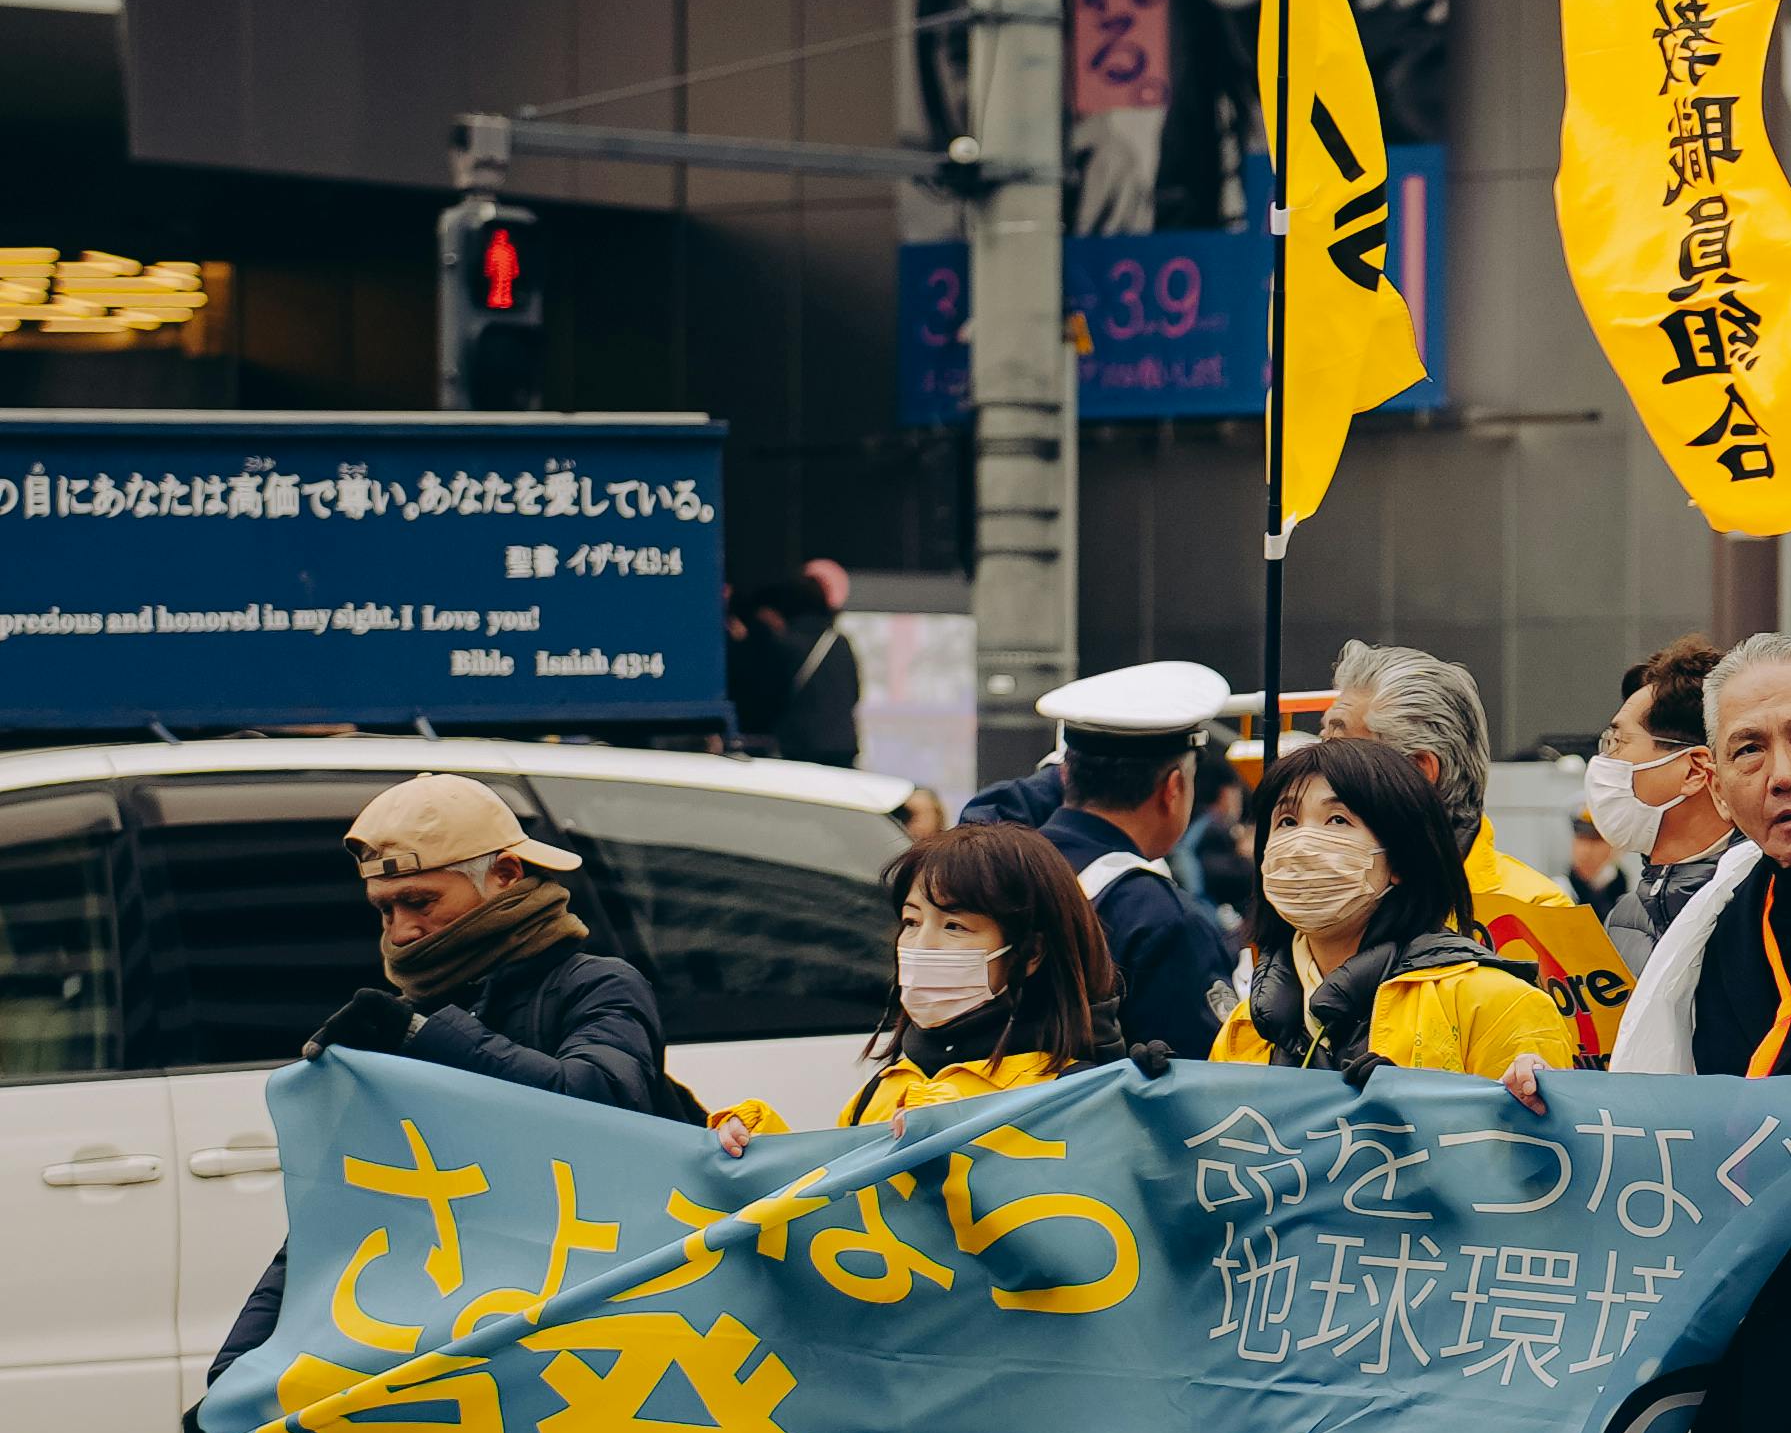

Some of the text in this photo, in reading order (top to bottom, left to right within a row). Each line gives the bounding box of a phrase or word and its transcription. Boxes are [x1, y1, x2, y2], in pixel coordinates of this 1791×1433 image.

[503, 543, 560, 579] 聖書
[0, 607, 103, 641] precious
[105, 606, 155, 634] and
[156, 604, 260, 632] honored
[261, 604, 291, 631] in
[292, 609, 332, 636] my
[421, 605, 480, 633] Love
[486, 605, 541, 637] you!
[449, 648, 666, 680] Bible Isaiah 43:4
[1547, 969, 1632, 1017] ore
